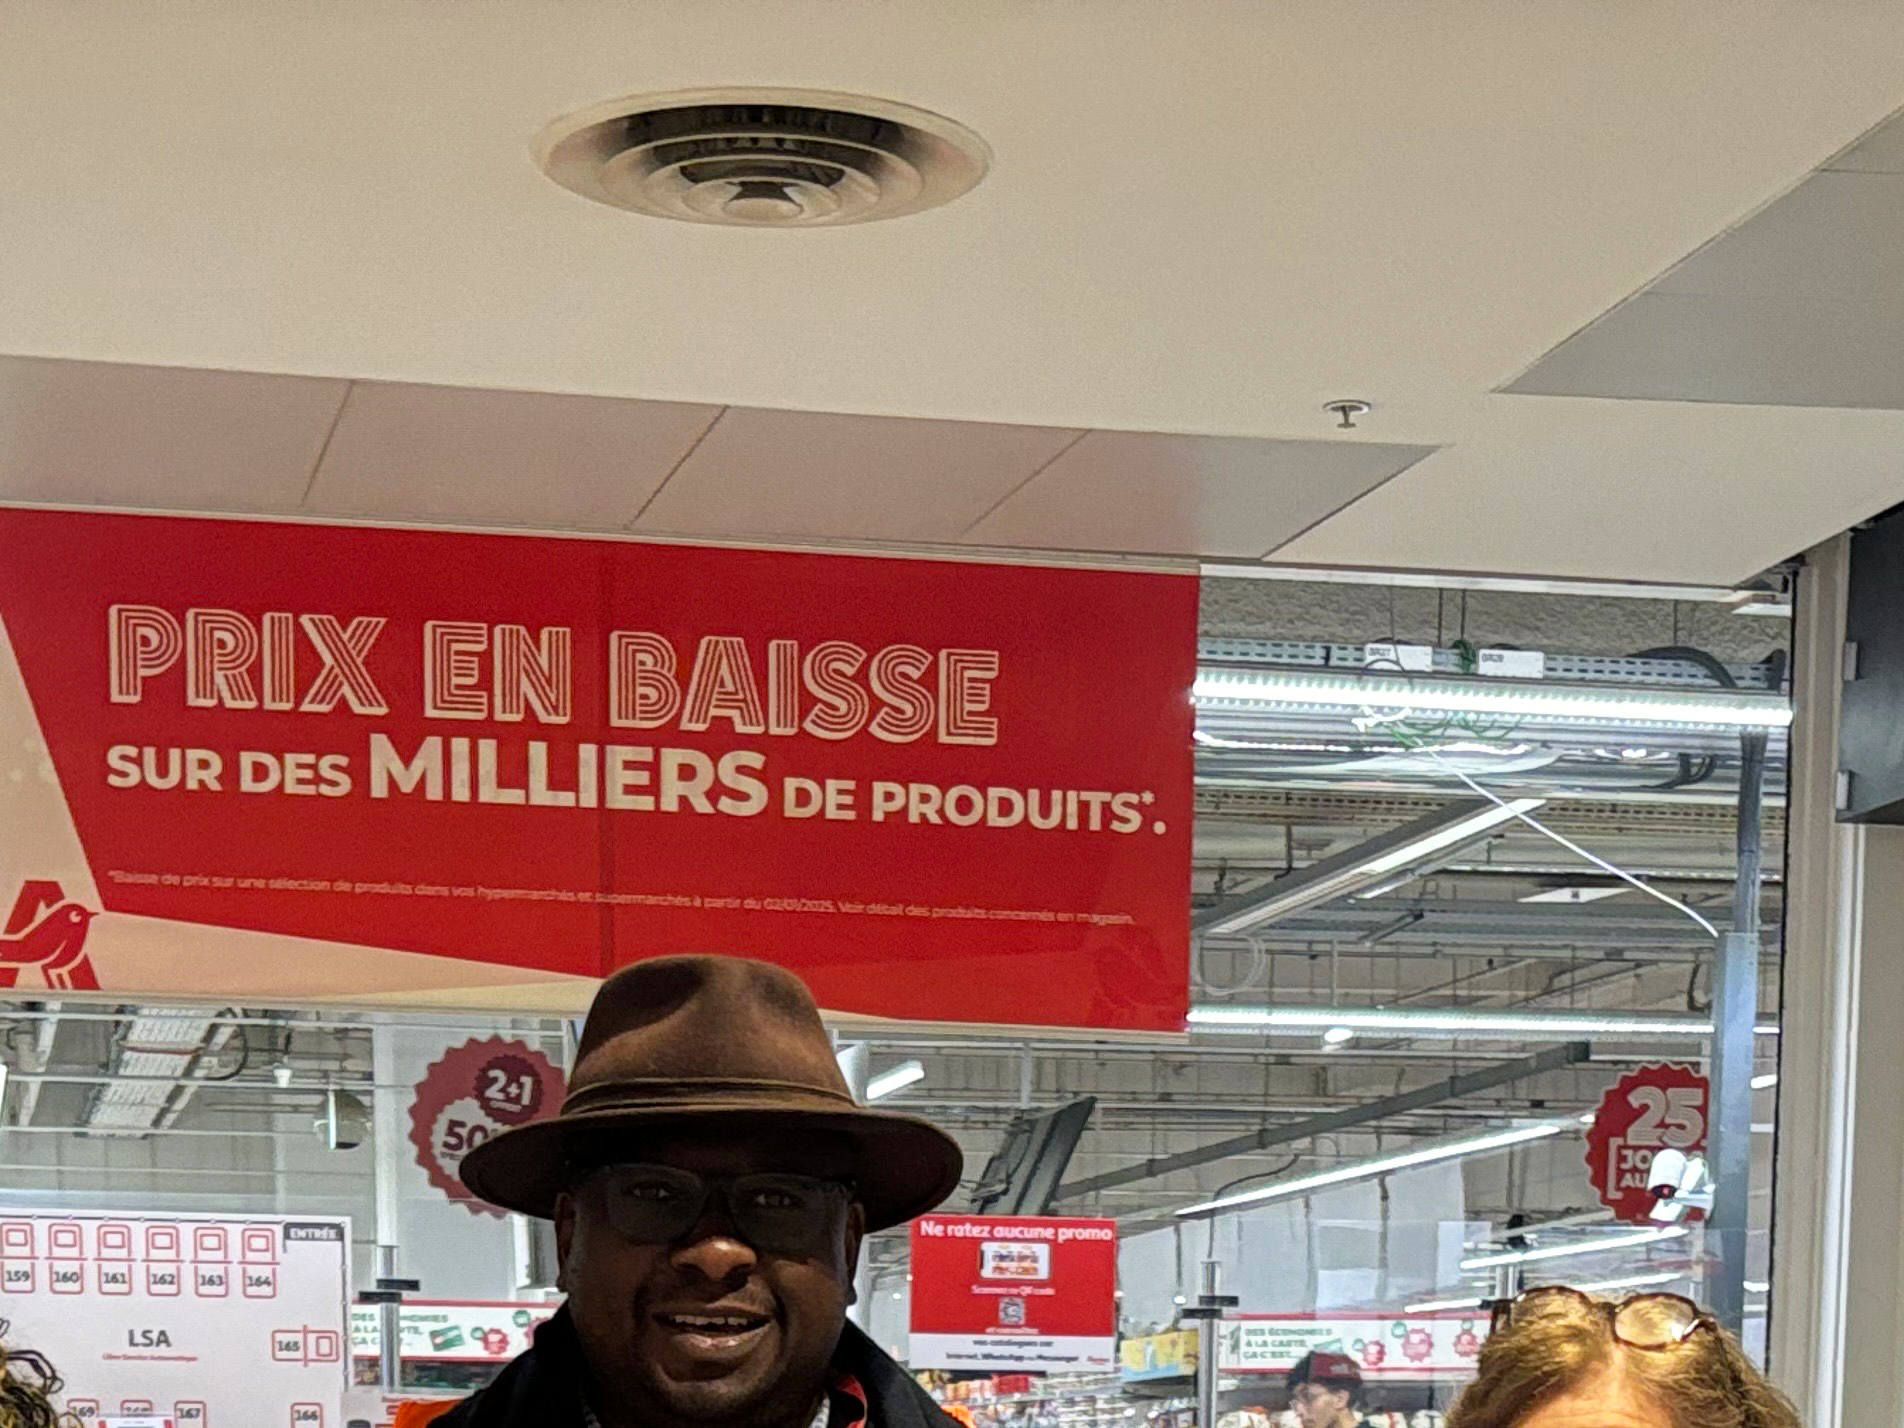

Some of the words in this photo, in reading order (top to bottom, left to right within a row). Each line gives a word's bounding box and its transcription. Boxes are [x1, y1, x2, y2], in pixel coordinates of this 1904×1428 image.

[108, 604, 388, 716] PRIX
[423, 620, 571, 726] EN
[609, 630, 1000, 746] BAISSE
[105, 744, 222, 793] SUR
[238, 752, 352, 797] DES
[368, 733, 769, 817] MILLIERS
[782, 776, 857, 820] DE
[484, 1069, 534, 1106] 2+1
[1627, 1084, 1705, 1148] 25
[920, 1220, 945, 1238] Ne
[947, 1222, 991, 1239] ratez
[993, 1224, 1056, 1241] aucune
[1057, 1227, 1114, 1244] promo
[4, 1269, 31, 1283] 159
[53, 1270, 80, 1284] 160
[102, 1271, 128, 1285] 161
[151, 1272, 176, 1287] 162
[199, 1273, 225, 1288] 163
[247, 1275, 272, 1288] 164
[127, 1328, 173, 1348] LSA
